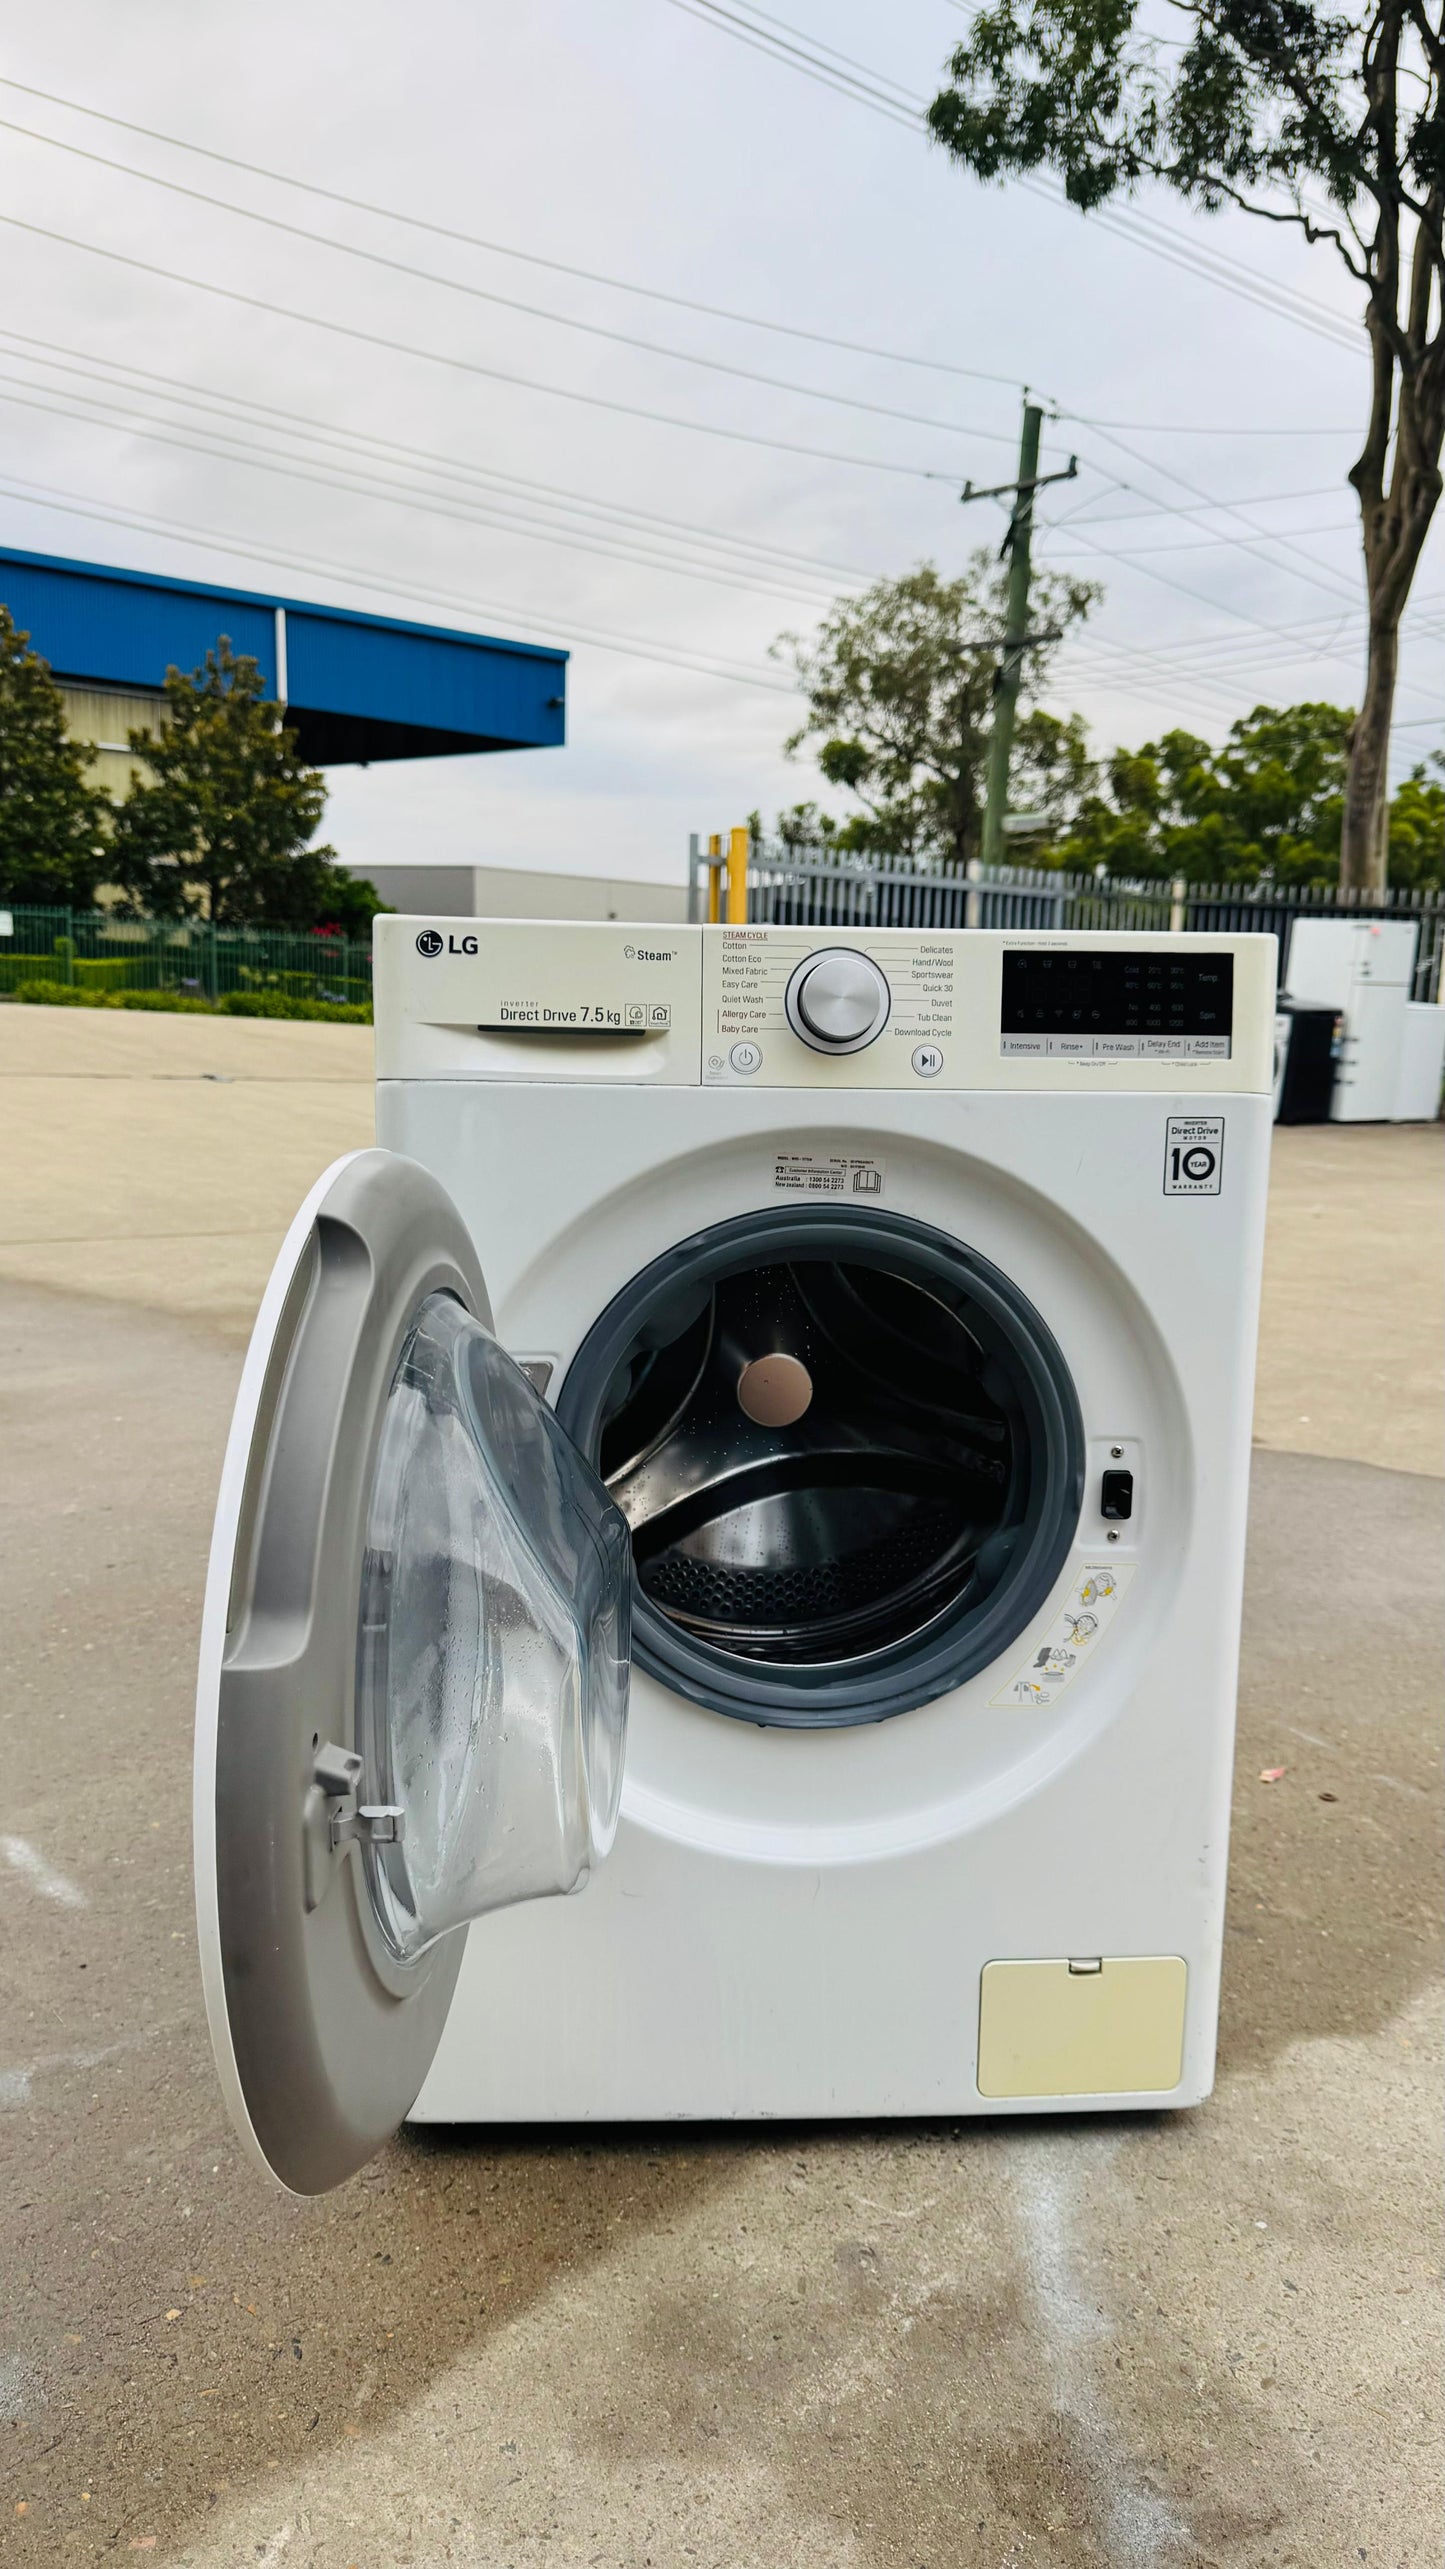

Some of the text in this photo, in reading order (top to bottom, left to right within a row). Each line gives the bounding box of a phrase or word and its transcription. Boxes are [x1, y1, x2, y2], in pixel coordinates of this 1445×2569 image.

[723, 931, 768, 940] STEAM CYCLE
[449, 935, 479, 956] LG
[723, 942, 747, 950] Cotton
[920, 946, 953, 954] Delicates
[722, 955, 762, 963] Cotton Eco
[912, 958, 953, 967] Hand/Wool
[722, 967, 768, 976] Mixed Fabric
[911, 971, 953, 980] Sportswear
[722, 980, 758, 989] Easy Care
[923, 984, 953, 993] Quick 30
[722, 995, 763, 1004] Quiet Wash
[931, 999, 953, 1007] Duvet
[580, 1007, 604, 1022] 7.5
[607, 1011, 621, 1025] kg
[722, 1010, 766, 1020] Allergy Care
[918, 1014, 952, 1022] Tub Clean
[722, 1025, 758, 1034] Baby Care
[895, 1028, 952, 1038] Download Cycle
[1010, 1042, 1041, 1050] Intensive
[1103, 1043, 1134, 1051] Pre Wash
[1147, 1040, 1181, 1048] Delay End
[1171, 1127, 1195, 1135] Direct
[1171, 1147, 1216, 1181] 10
